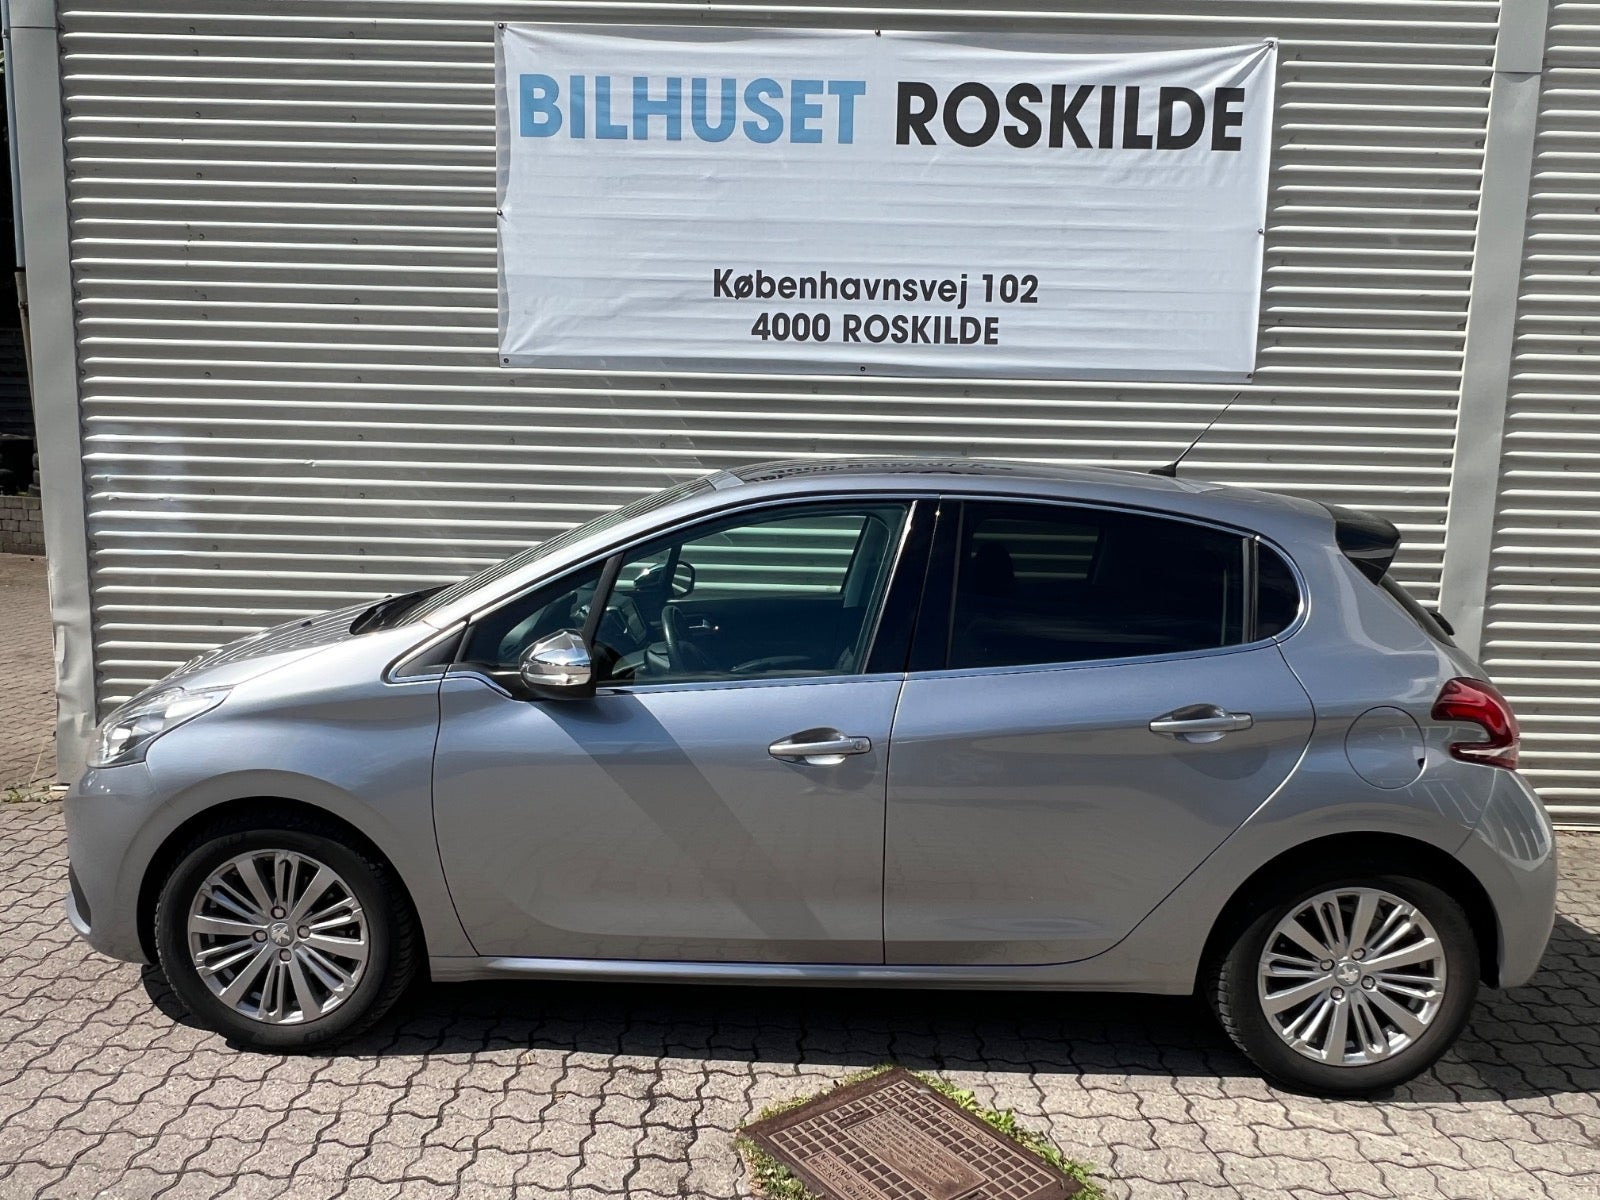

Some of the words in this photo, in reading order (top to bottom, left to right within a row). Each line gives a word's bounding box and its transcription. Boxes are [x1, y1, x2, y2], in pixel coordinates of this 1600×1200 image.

[519, 73, 867, 145] BILHUSET
[896, 81, 1244, 152] ROSKILDE
[713, 268, 967, 310] Københavnsvej
[982, 274, 1038, 304] 102
[751, 312, 831, 342] 4000
[843, 314, 999, 345] ROSKILDE
